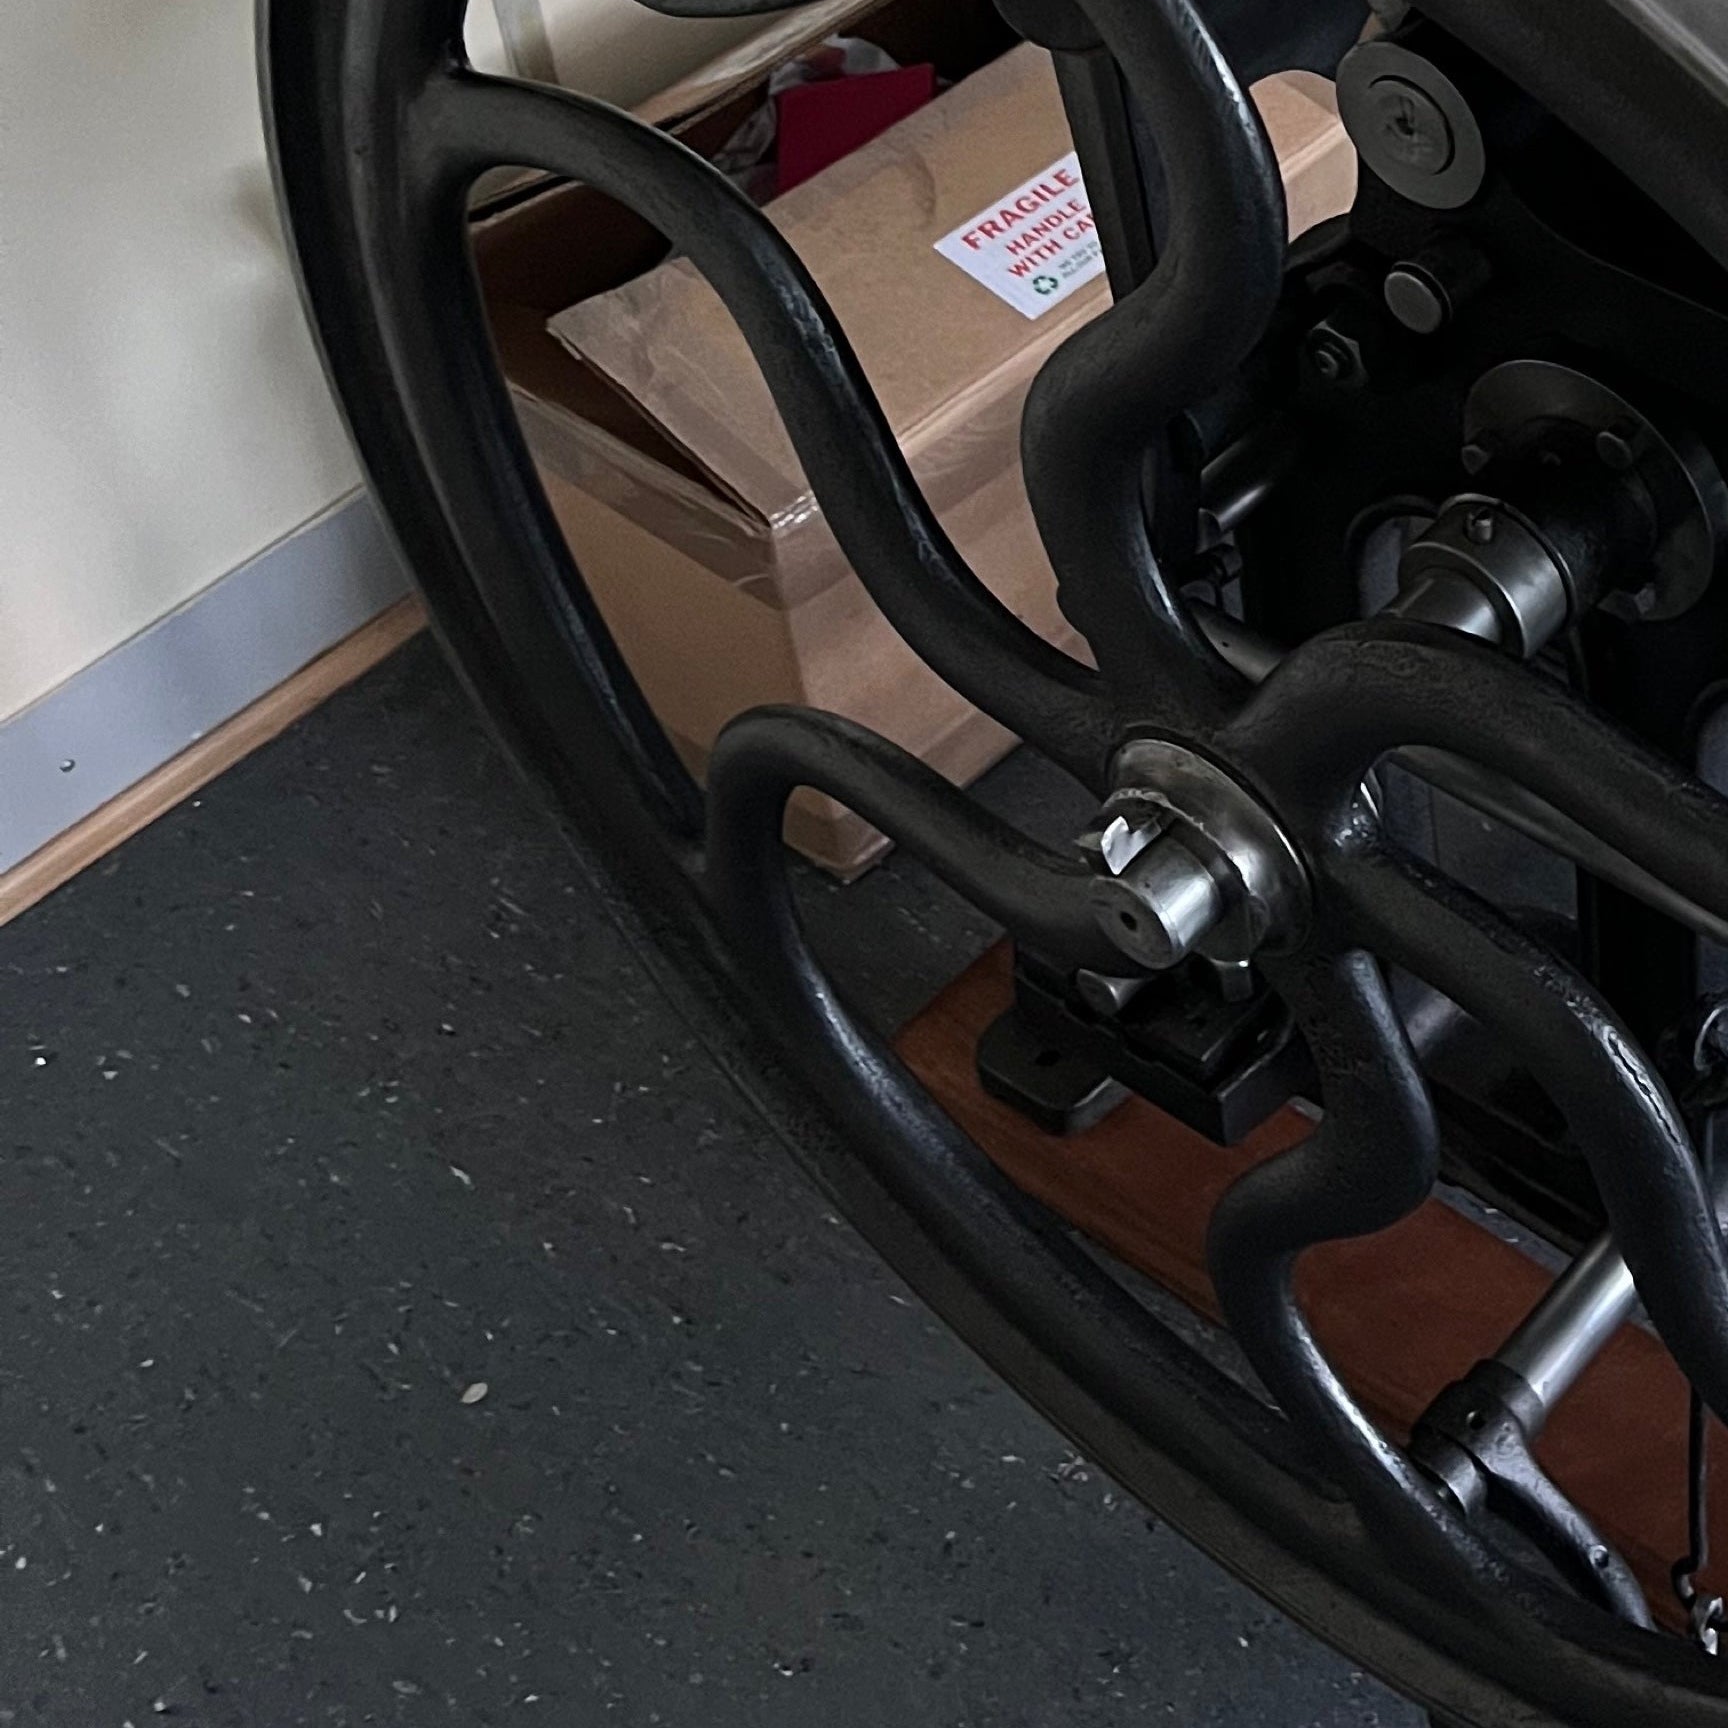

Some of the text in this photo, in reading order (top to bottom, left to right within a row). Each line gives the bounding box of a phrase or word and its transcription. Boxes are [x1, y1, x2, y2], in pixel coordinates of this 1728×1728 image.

[962, 168, 1079, 251] FRAGILE
[1005, 198, 1086, 255] HANDLE
[1008, 241, 1063, 278] WITH
